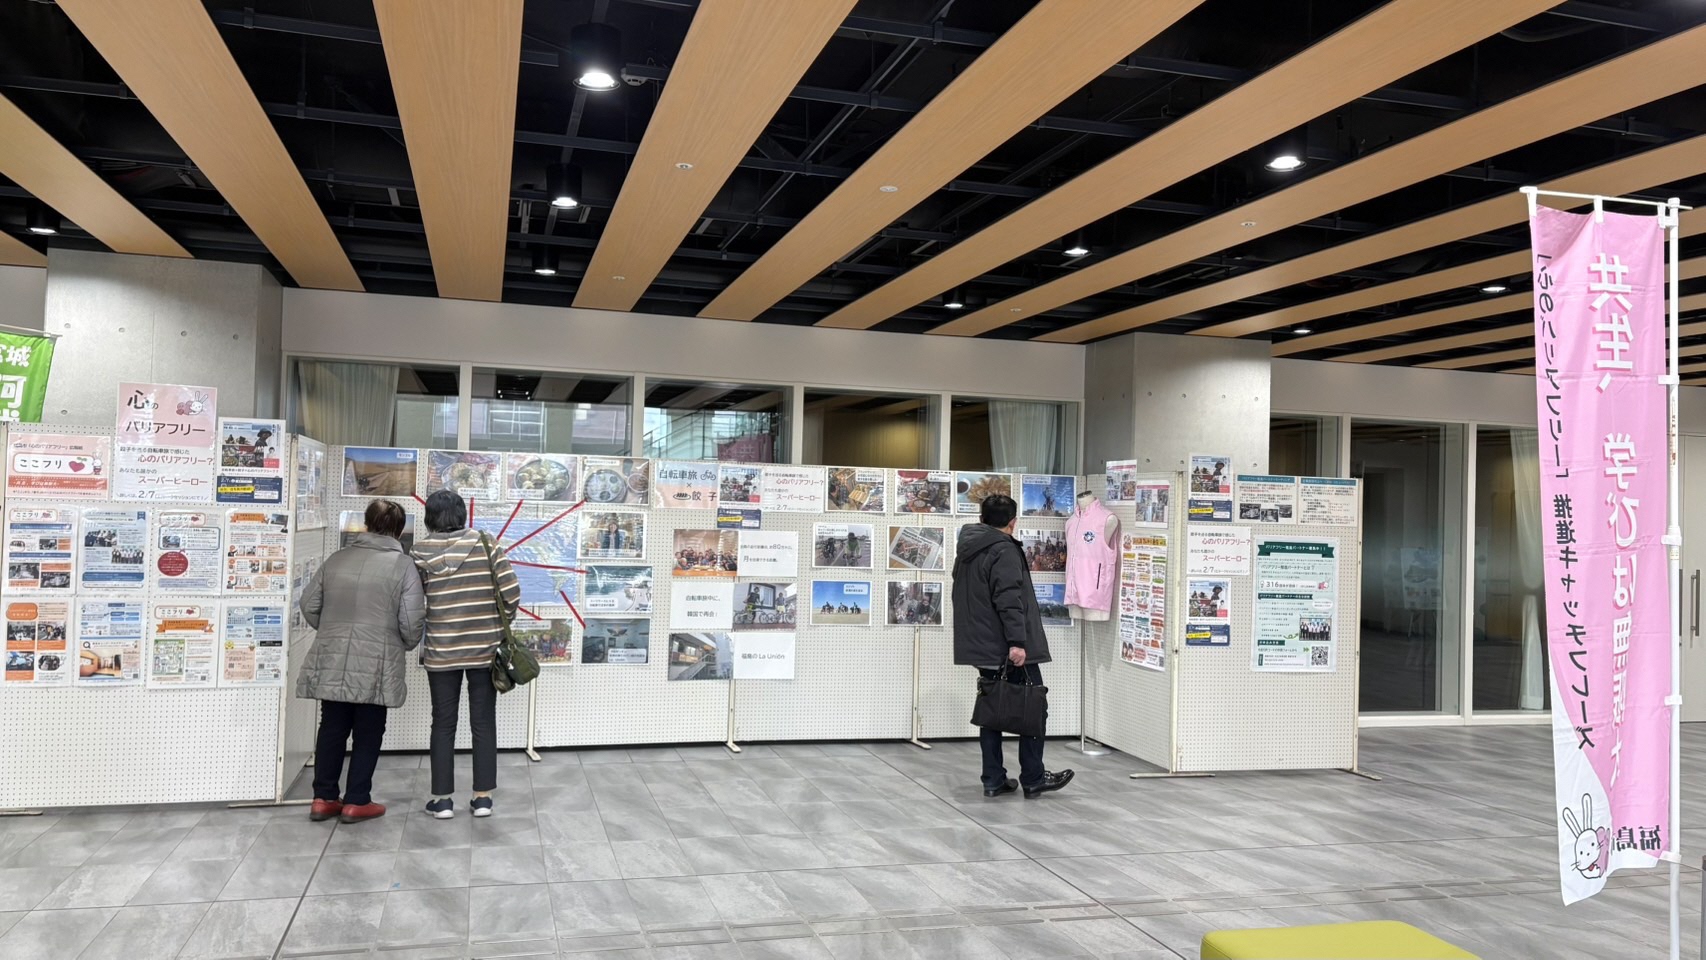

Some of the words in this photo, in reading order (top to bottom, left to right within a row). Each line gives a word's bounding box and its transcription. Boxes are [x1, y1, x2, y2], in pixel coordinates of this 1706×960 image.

[125, 420, 206, 437] バリアフリー
[20, 459, 62, 469] ここフリ
[659, 468, 697, 480] 自転車旅
[138, 475, 208, 486] スーパーヒーロー
[692, 490, 717, 502] 餃子
[1202, 554, 1248, 562] スーパーヒーロー
